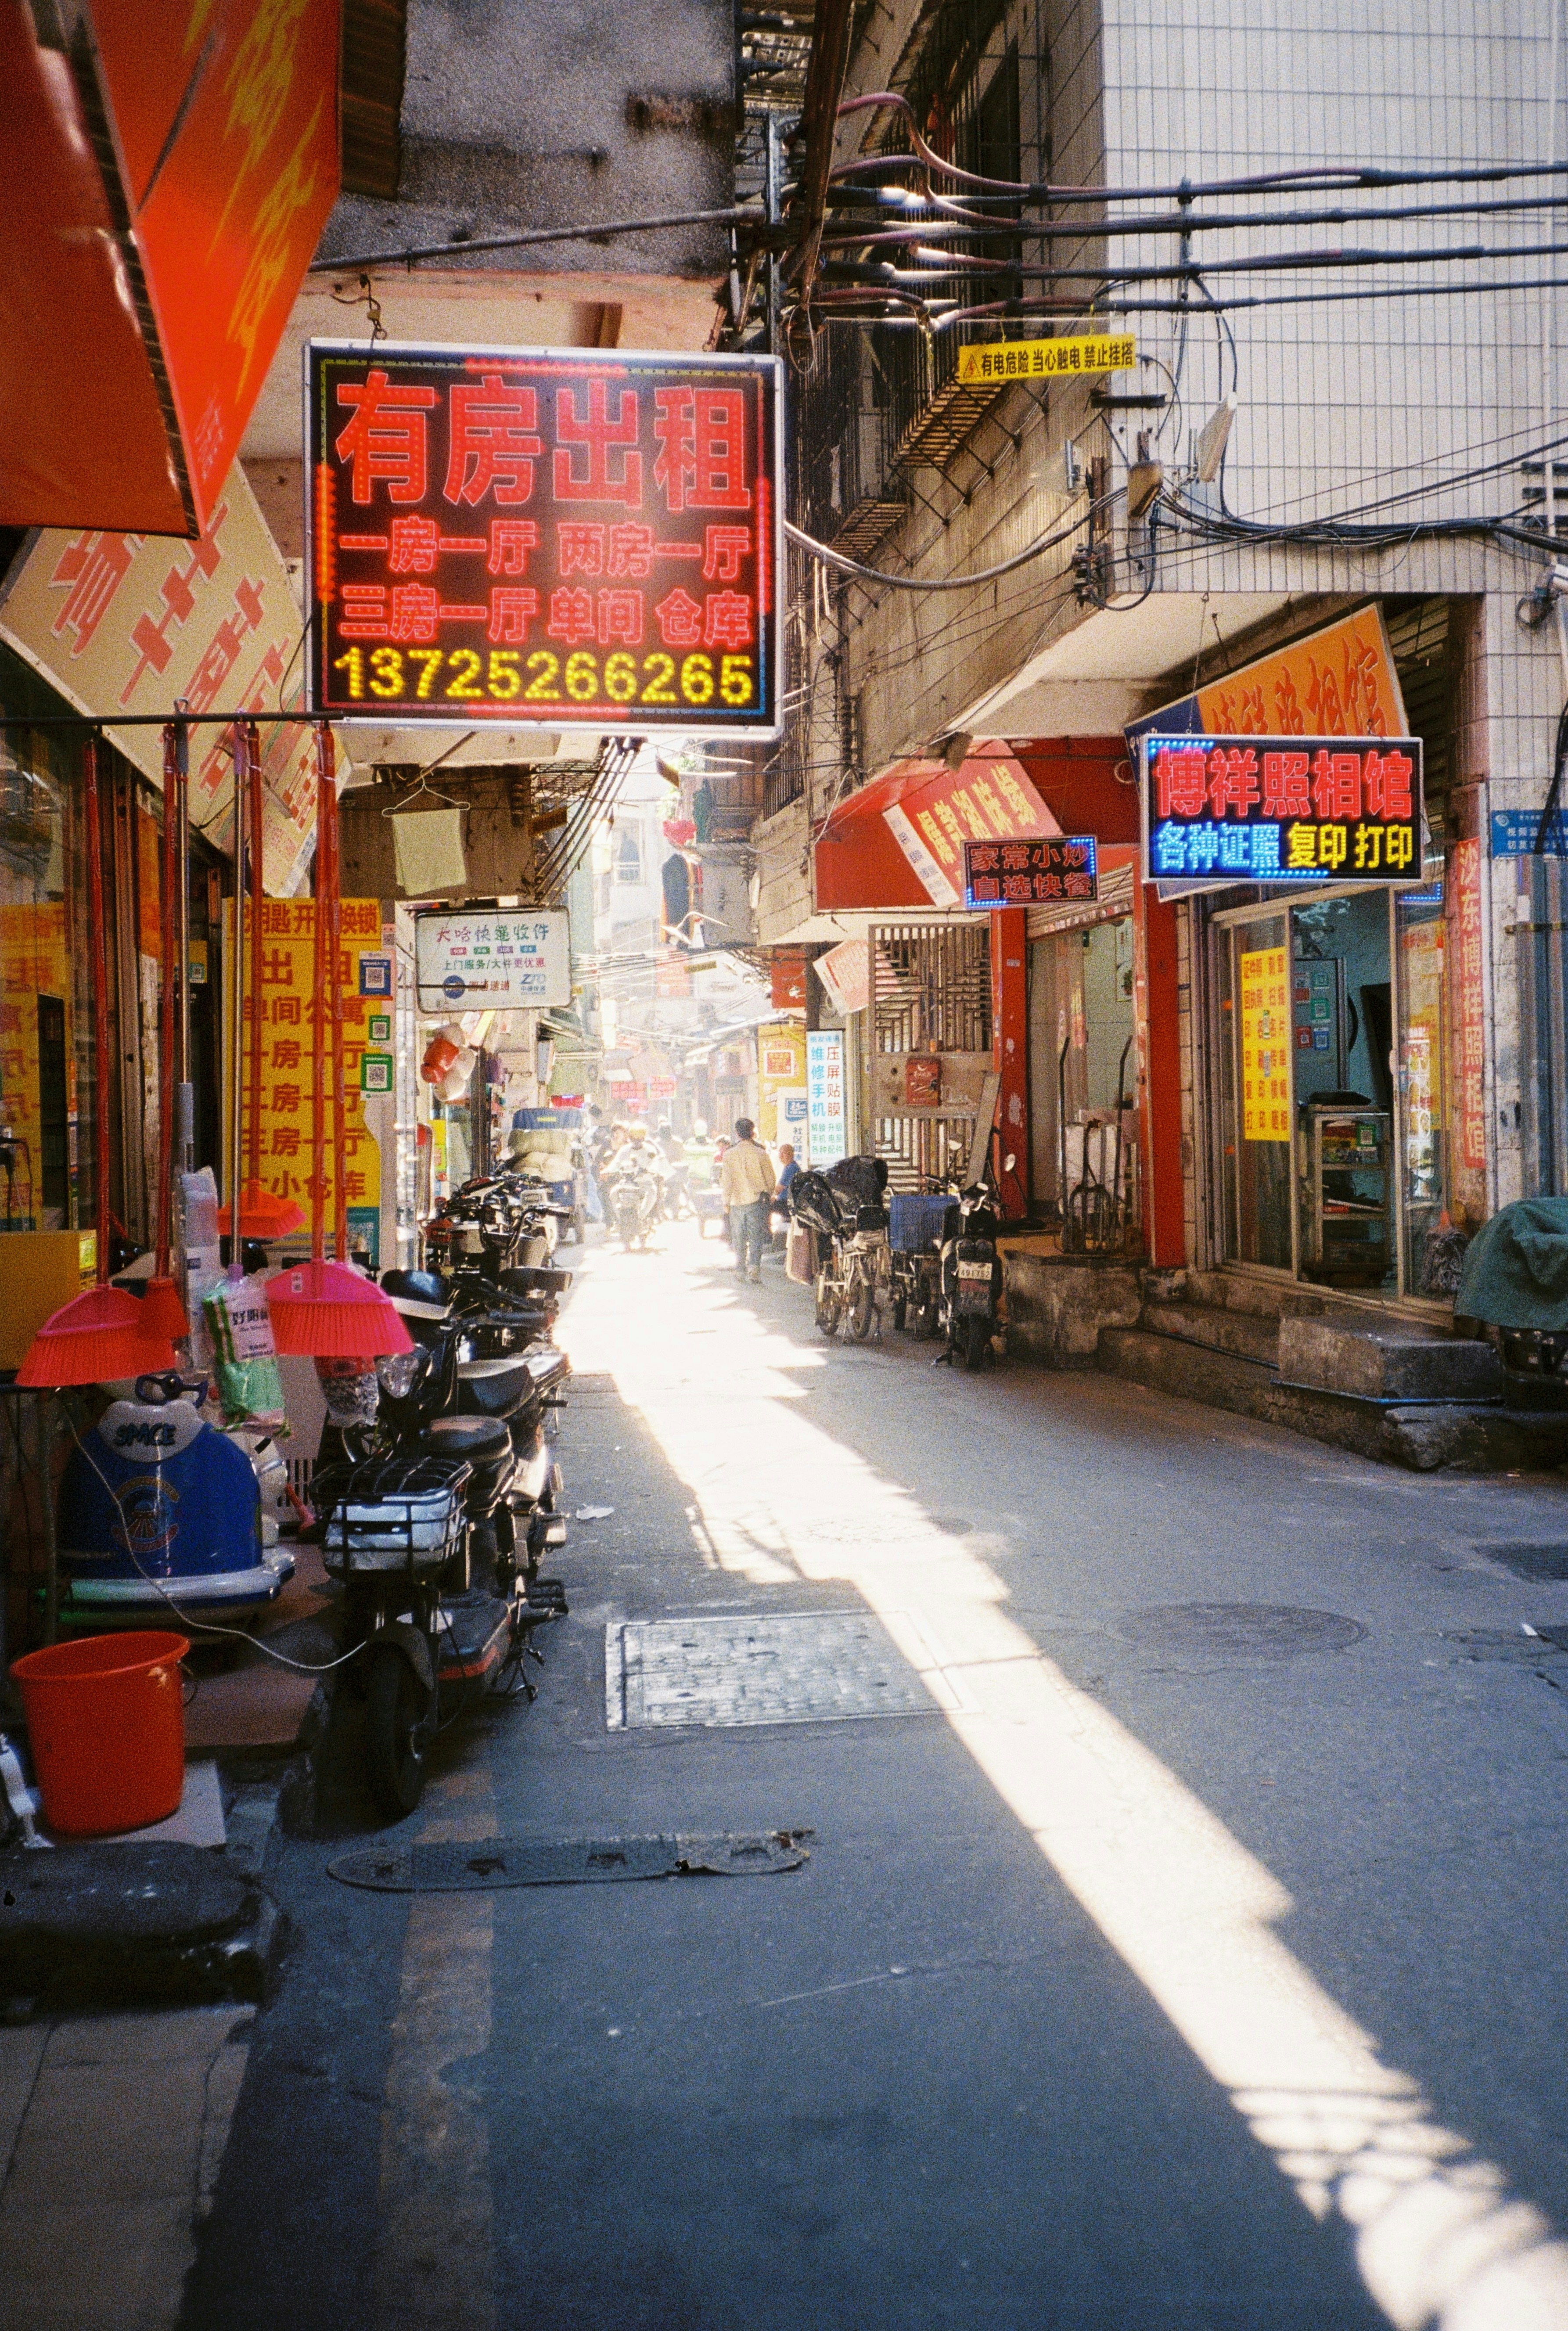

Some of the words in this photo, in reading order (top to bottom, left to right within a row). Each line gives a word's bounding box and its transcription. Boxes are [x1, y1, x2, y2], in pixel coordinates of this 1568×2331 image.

[982, 349, 1029, 378] 有电危险
[1033, 345, 1081, 373] 当心触电
[1084, 340, 1134, 368] 禁止挂搭
[334, 371, 752, 511] 有房出租
[339, 515, 539, 575] 一房一厅
[557, 522, 751, 580] 两房一厅
[339, 582, 538, 644] 三房一厅
[547, 586, 644, 646] 单间
[654, 588, 753, 650] 仓库
[334, 646, 754, 705] 13725266265
[1155, 746, 1413, 818] 博祥照相馆
[971, 843, 1090, 871] 家常小炒
[1157, 820, 1281, 870] 各种证照
[1287, 822, 1347, 870] 复印
[1354, 823, 1413, 870] 打印
[973, 872, 1093, 901] 自选快餐
[1459, 842, 1485, 1159] 沙东博祥照相馆
[811, 1047, 826, 1118] 维修手机
[827, 1047, 842, 1117] 压屏贴膜
